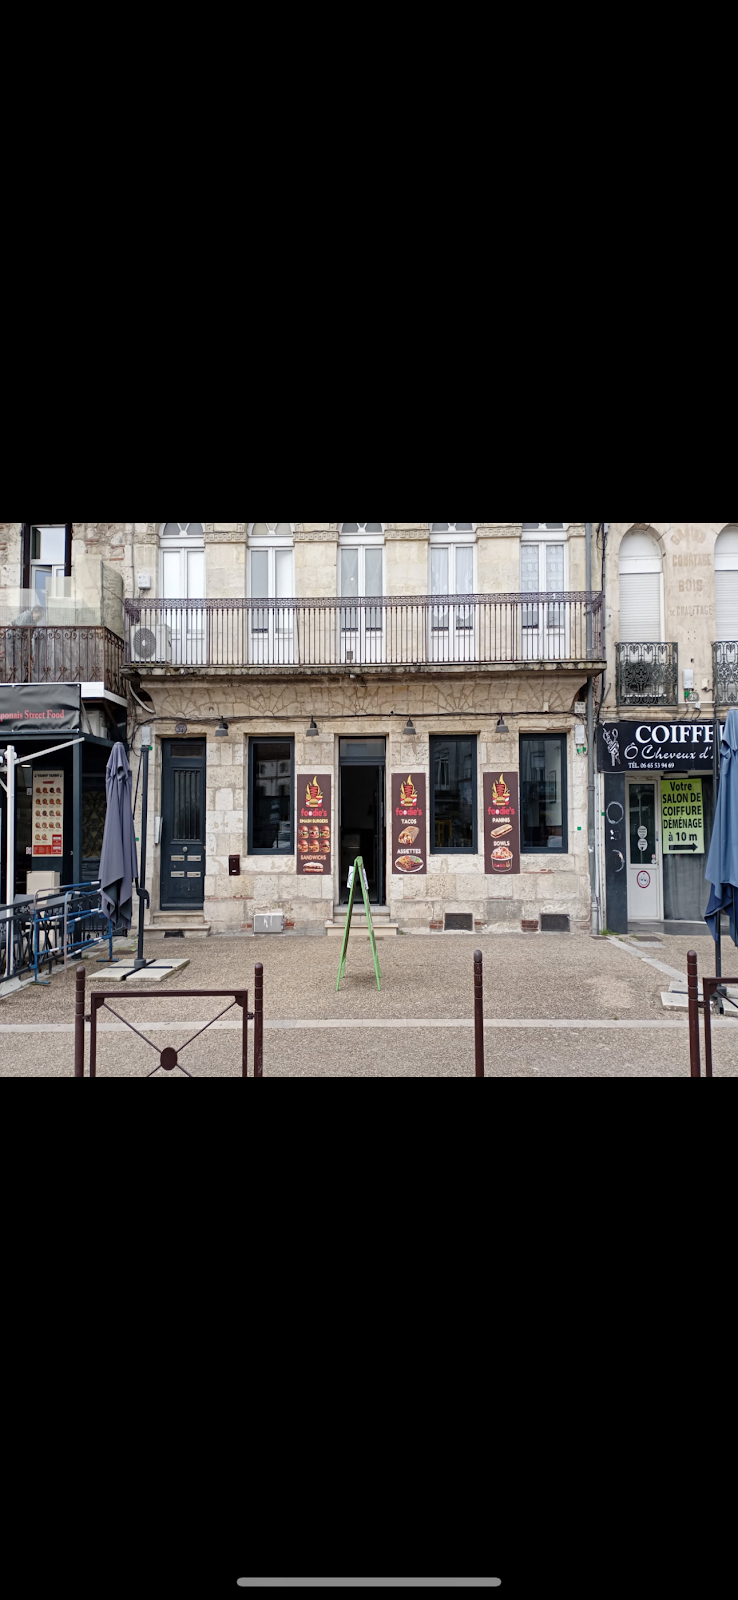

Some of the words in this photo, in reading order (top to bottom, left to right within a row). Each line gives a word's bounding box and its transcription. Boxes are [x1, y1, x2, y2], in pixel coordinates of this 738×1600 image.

[678, 579, 703, 592] BOIS
[0, 711, 23, 722] ponais
[24, 709, 45, 719] Street
[46, 709, 65, 719] Food
[635, 724, 724, 743] COIFFE
[624, 742, 639, 759] Ô
[641, 744, 696, 759] Cheveux
[699, 746, 714, 759] d'
[670, 782, 692, 791] Votre
[662, 793, 689, 804] SALON
[690, 793, 702, 802] DE
[301, 808, 328, 817] foodie's
[395, 807, 423, 816] foodie's
[487, 806, 515, 815] foodie's
[662, 805, 702, 816] COIFFURE
[663, 817, 702, 829] DÉMÉNAGE
[668, 831, 674, 841] à
[676, 832, 687, 841] 10
[689, 833, 697, 841] m
